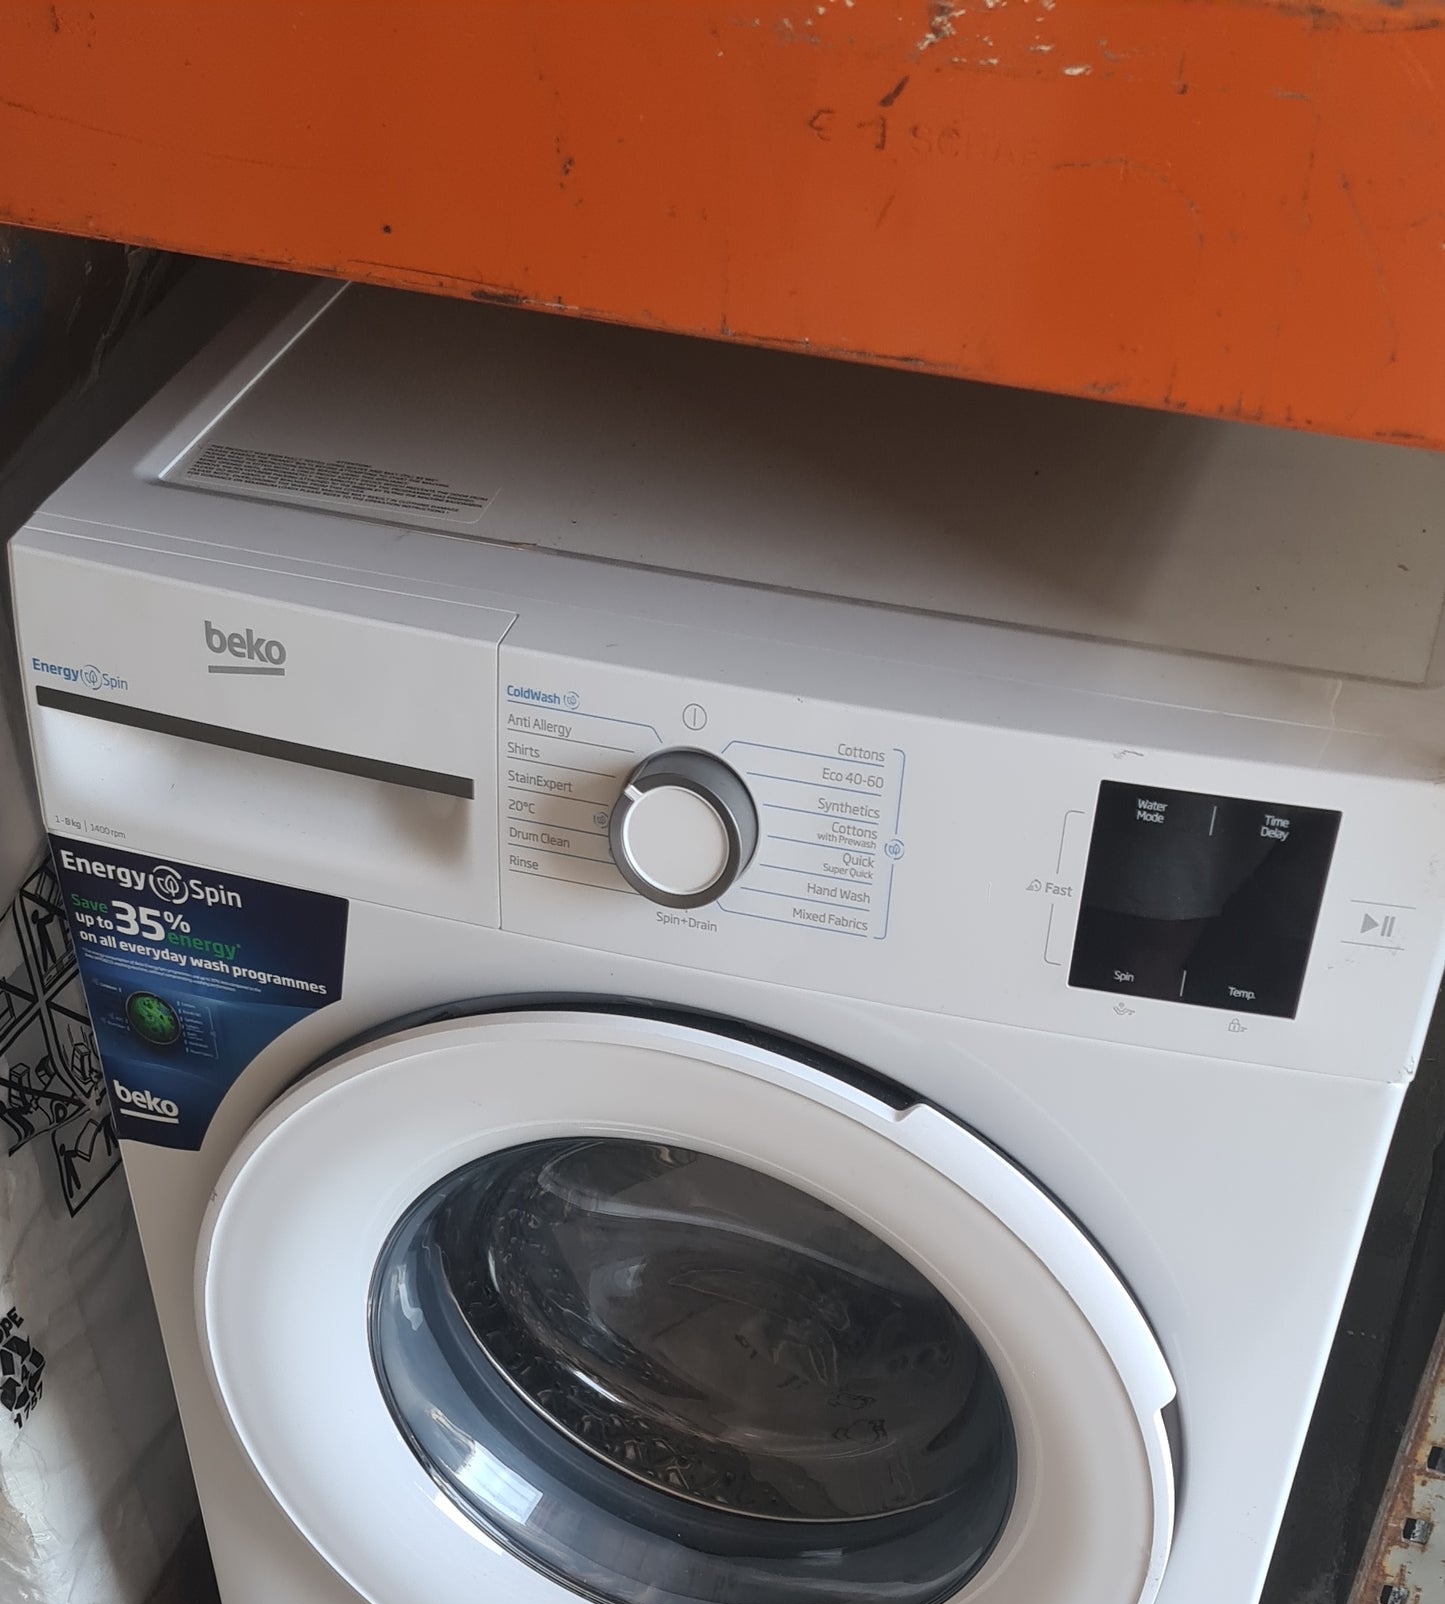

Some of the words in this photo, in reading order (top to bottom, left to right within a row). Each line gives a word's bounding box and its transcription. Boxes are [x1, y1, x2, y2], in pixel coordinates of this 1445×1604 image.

[204, 620, 286, 665] beko
[32, 657, 79, 681] Energy
[102, 673, 128, 690] Spin
[507, 685, 560, 704] ColdWash
[508, 713, 531, 728] Anti
[533, 718, 572, 738] Allergy
[507, 741, 540, 758] Shirts
[838, 743, 885, 762] Cottons
[508, 769, 572, 792] StainExpert
[822, 767, 843, 782] Eco
[845, 772, 884, 789] 40-60
[818, 797, 880, 818] Synthetics
[1137, 798, 1168, 812] Water
[1136, 810, 1165, 824] Mode
[1265, 814, 1290, 828] Time
[509, 826, 539, 842] Drum
[540, 832, 570, 848] Clean
[831, 821, 878, 840] Cottons
[1260, 826, 1289, 841] Delay
[817, 832, 838, 844] with
[838, 834, 876, 850] Prewash
[509, 854, 539, 870] Rinse
[842, 852, 874, 868] Quick
[60, 849, 146, 891] Energy
[189, 879, 242, 908] Spin
[823, 862, 848, 875] Super
[849, 867, 874, 879] Quick
[807, 882, 837, 898] Hand
[839, 887, 871, 904] Wash
[1044, 882, 1073, 897] Fast
[71, 893, 108, 914] Save
[75, 912, 95, 928] up
[98, 916, 114, 930] to
[656, 911, 718, 932] Spin+Drain
[792, 907, 826, 923] Mixed
[828, 914, 868, 931] Fabrics
[79, 930, 98, 944] on
[100, 936, 117, 949] all
[119, 940, 187, 967] everyday
[190, 953, 230, 974] wash
[232, 964, 328, 995] programmes
[1113, 969, 1135, 983] Spin
[113, 1079, 179, 1117] beko
